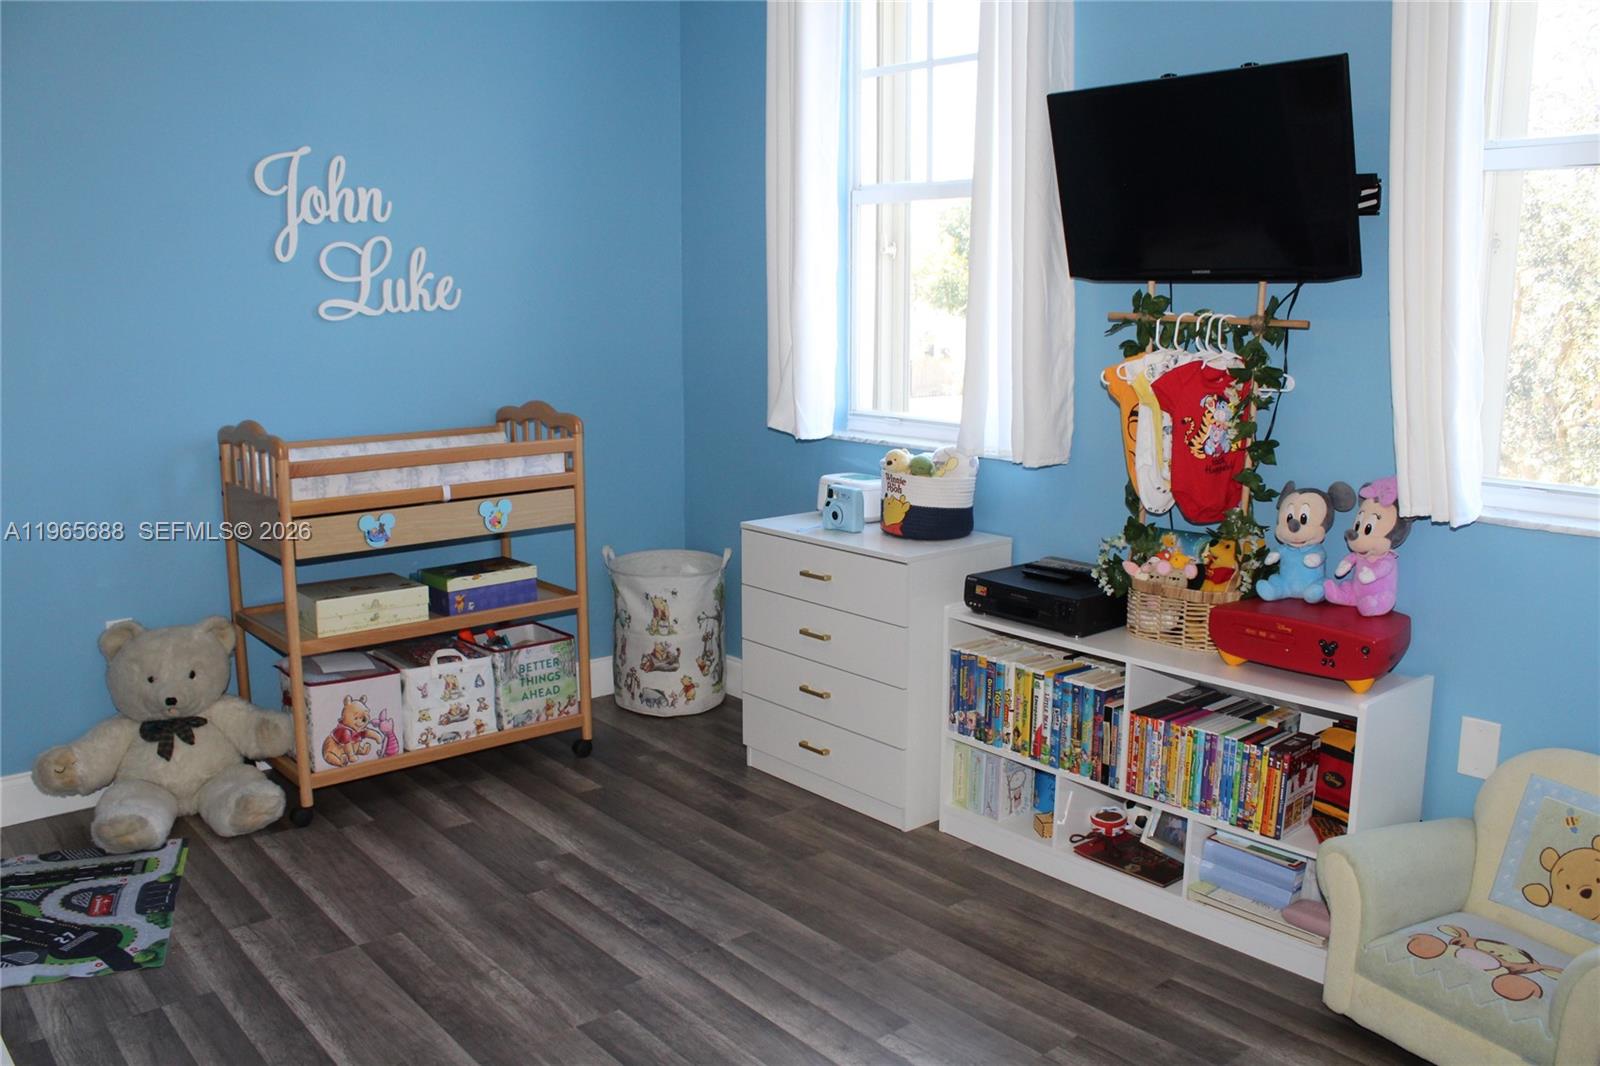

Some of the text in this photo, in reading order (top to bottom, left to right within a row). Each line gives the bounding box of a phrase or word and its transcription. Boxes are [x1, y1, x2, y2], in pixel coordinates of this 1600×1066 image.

[254, 146, 392, 263] John
[318, 236, 462, 321] Luke
[885, 472, 907, 486] Winnie
[886, 481, 903, 494] Pooh
[518, 657, 560, 674] BETTER
[519, 670, 561, 687] THINGS
[521, 685, 561, 701] AHEAD
[54, 931, 76, 944] 27
